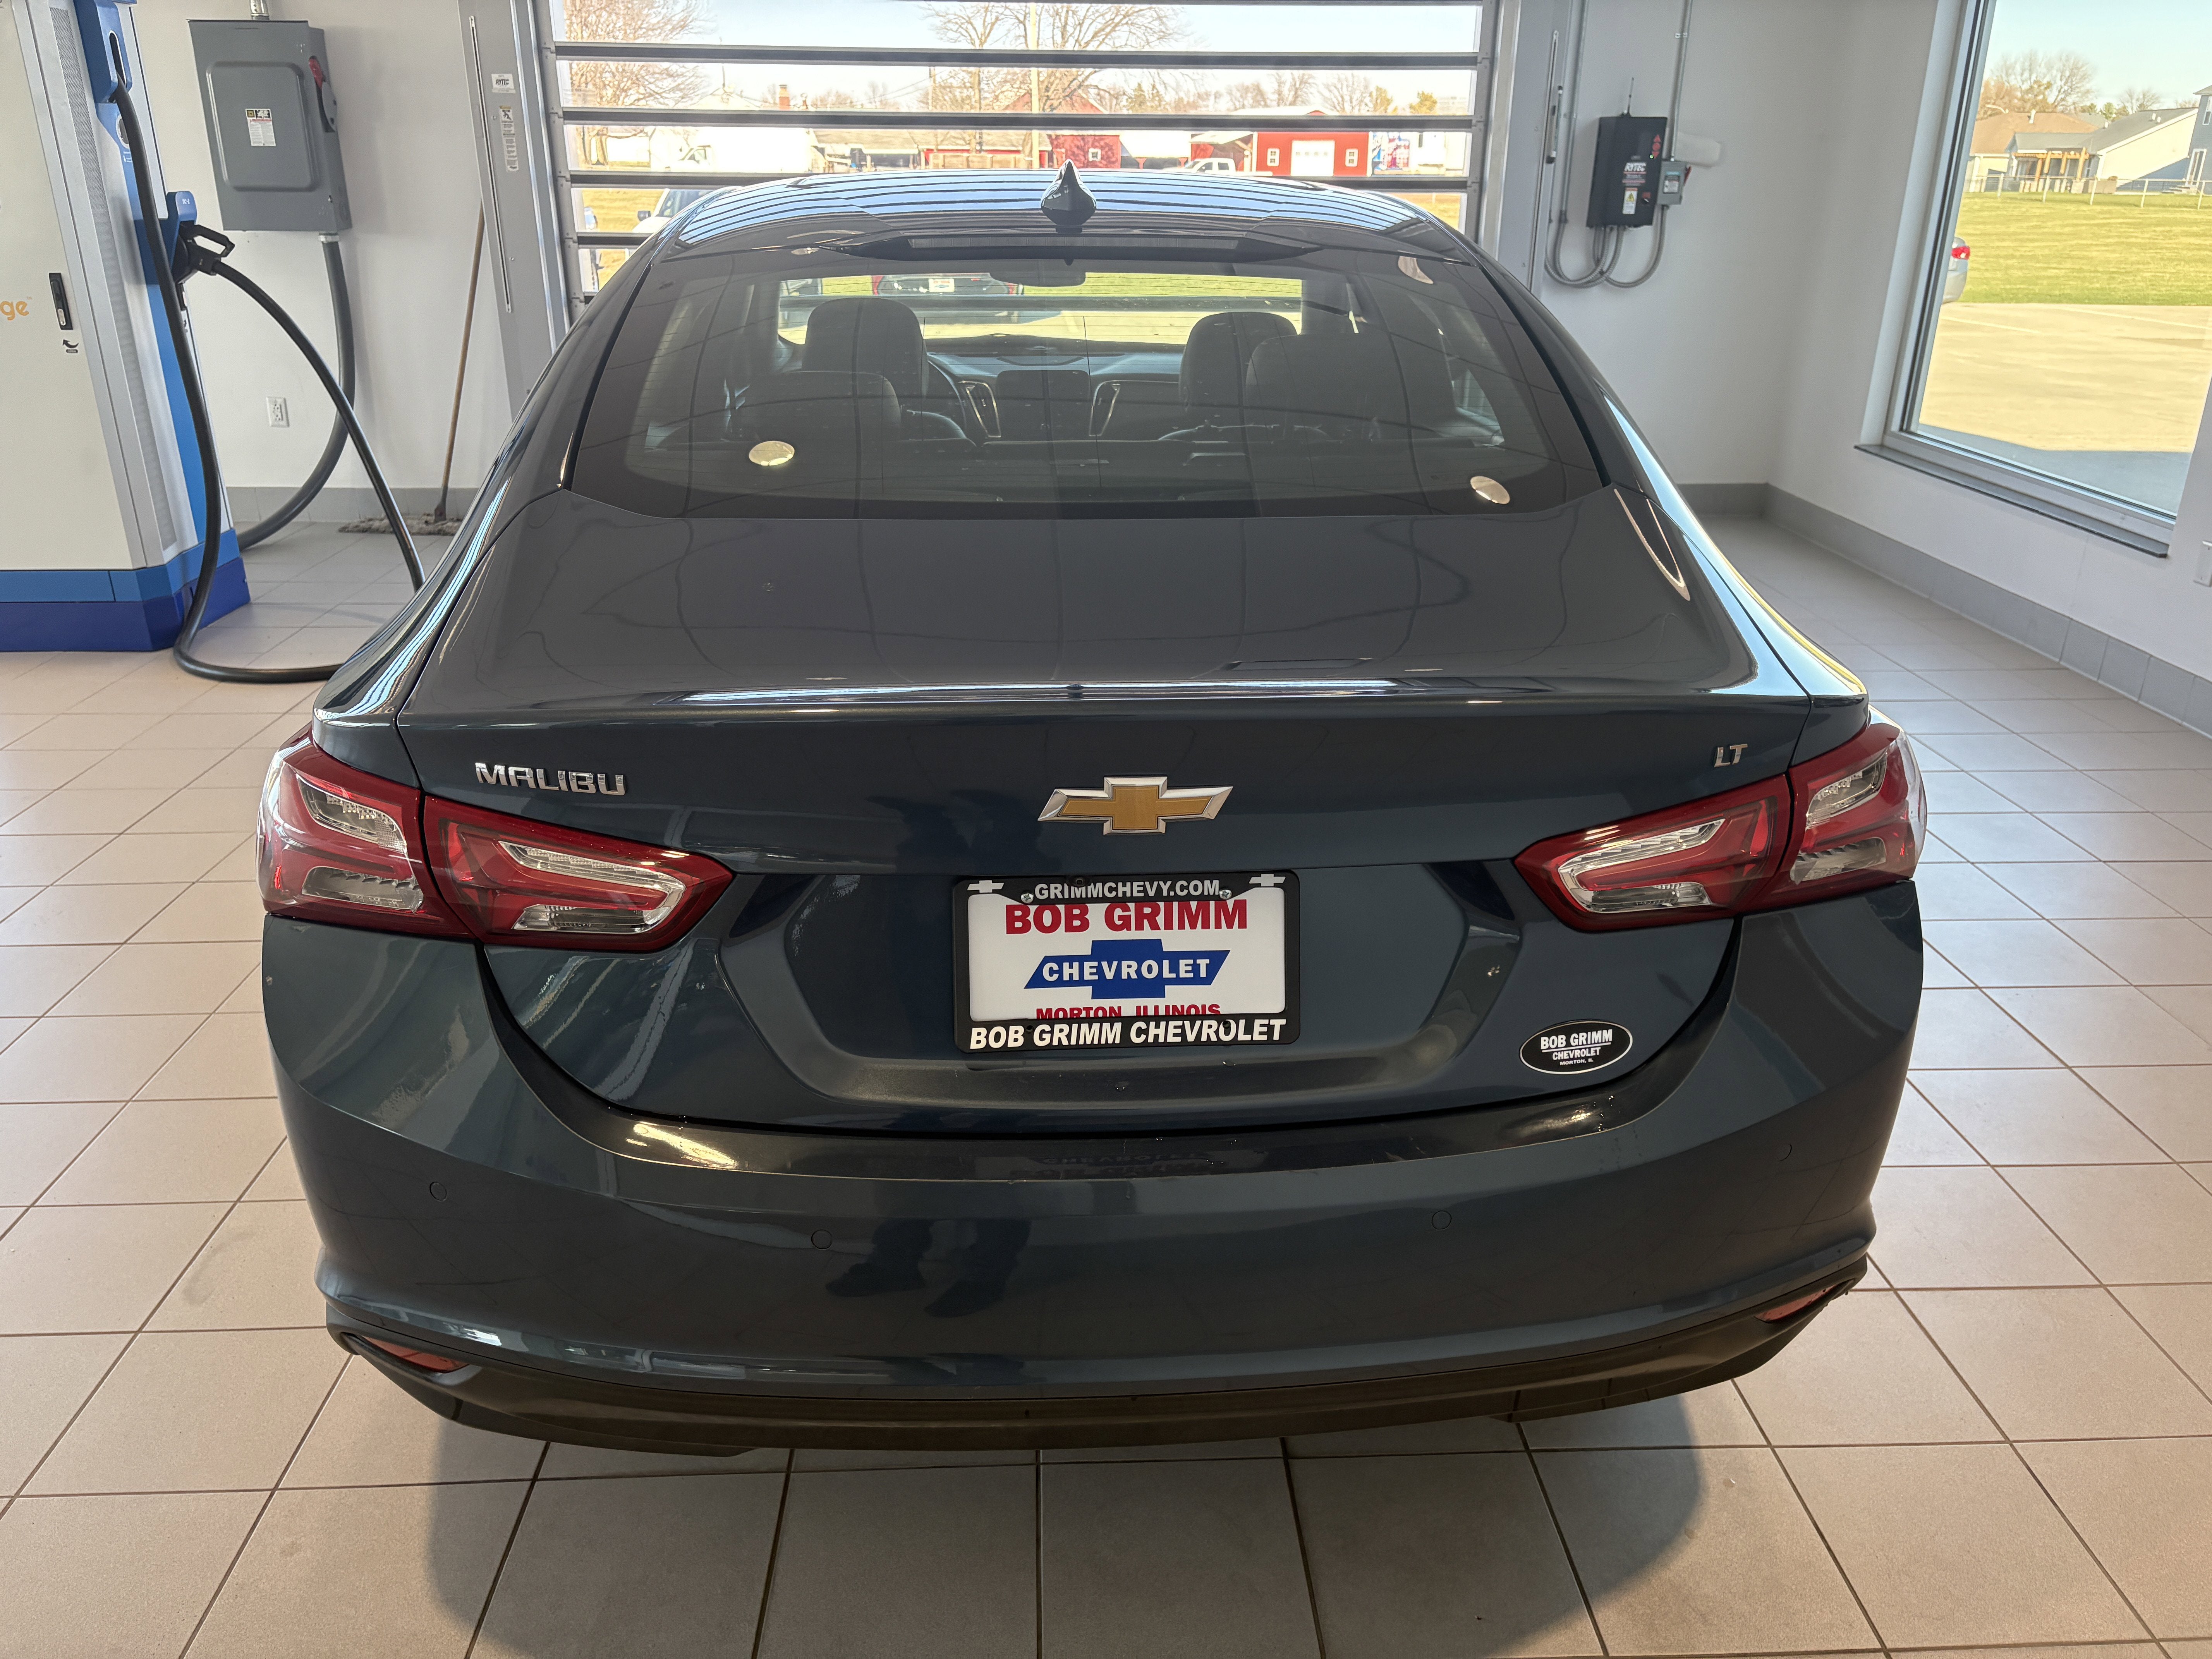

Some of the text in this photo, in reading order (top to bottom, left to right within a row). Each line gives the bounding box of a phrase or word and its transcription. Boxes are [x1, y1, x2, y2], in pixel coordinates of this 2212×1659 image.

[1714, 744, 1748, 768] LT
[475, 763, 625, 795] MALIBU
[1035, 880, 1219, 900] GRIMMCHEVY.COM
[1006, 899, 1247, 934] BOB GRIMM
[1043, 959, 1210, 981] CHEVROLET
[970, 1019, 1286, 1049] BOB GRIMM CHEVROLET
[1541, 1029, 1613, 1049] BOB GRIMM
[1553, 1047, 1601, 1060] CHEVROLET
